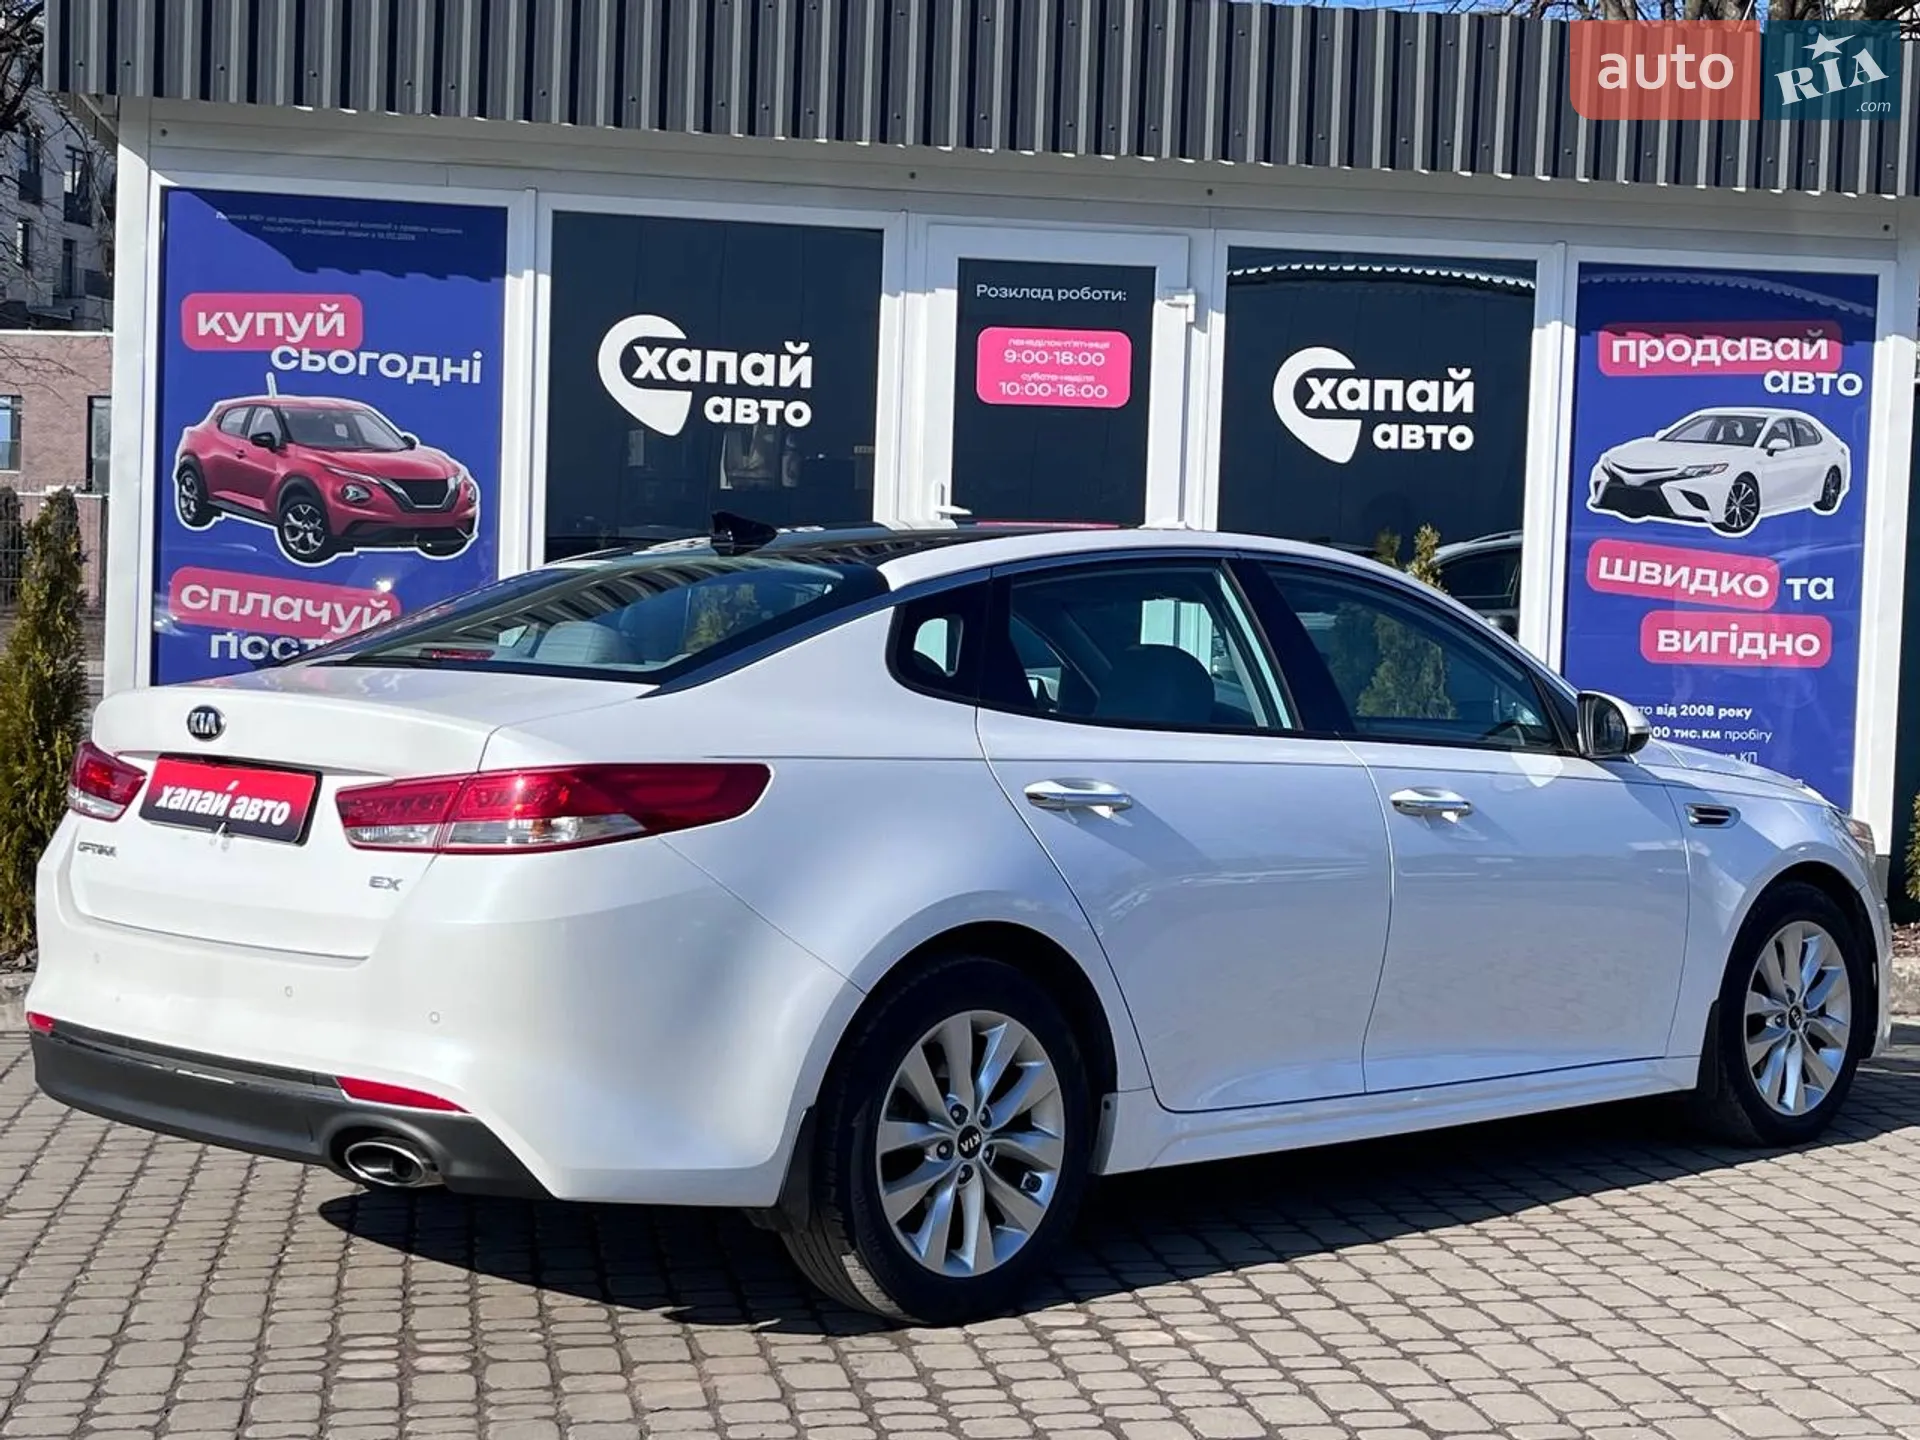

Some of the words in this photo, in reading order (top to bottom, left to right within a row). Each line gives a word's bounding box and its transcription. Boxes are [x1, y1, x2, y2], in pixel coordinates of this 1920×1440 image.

[976, 284, 1054, 301] Розклад
[1058, 287, 1127, 302] роботи:
[197, 303, 345, 343] купуй
[1004, 349, 1105, 366] 9:00-18:00
[1612, 329, 1829, 368] продавай
[270, 345, 482, 386] сьогодні
[632, 341, 813, 388] хапай
[999, 382, 1108, 399] 10:00-16:00
[1305, 367, 1474, 413] хапай
[1763, 370, 1863, 396] авто
[704, 396, 812, 428] авто
[1372, 423, 1474, 451] авто
[1598, 556, 1769, 598] швидко
[1785, 576, 1835, 600] та
[180, 584, 391, 635] сплачуй
[1656, 623, 1821, 660] вигідно
[190, 712, 217, 734] KIA
[1656, 703, 1677, 718] від
[1680, 704, 1714, 717] 2008
[1718, 707, 1752, 720] року
[1650, 726, 1670, 738] 00
[1724, 728, 1773, 743] пробігу
[229, 795, 291, 826] авто
[369, 875, 402, 891] EX
